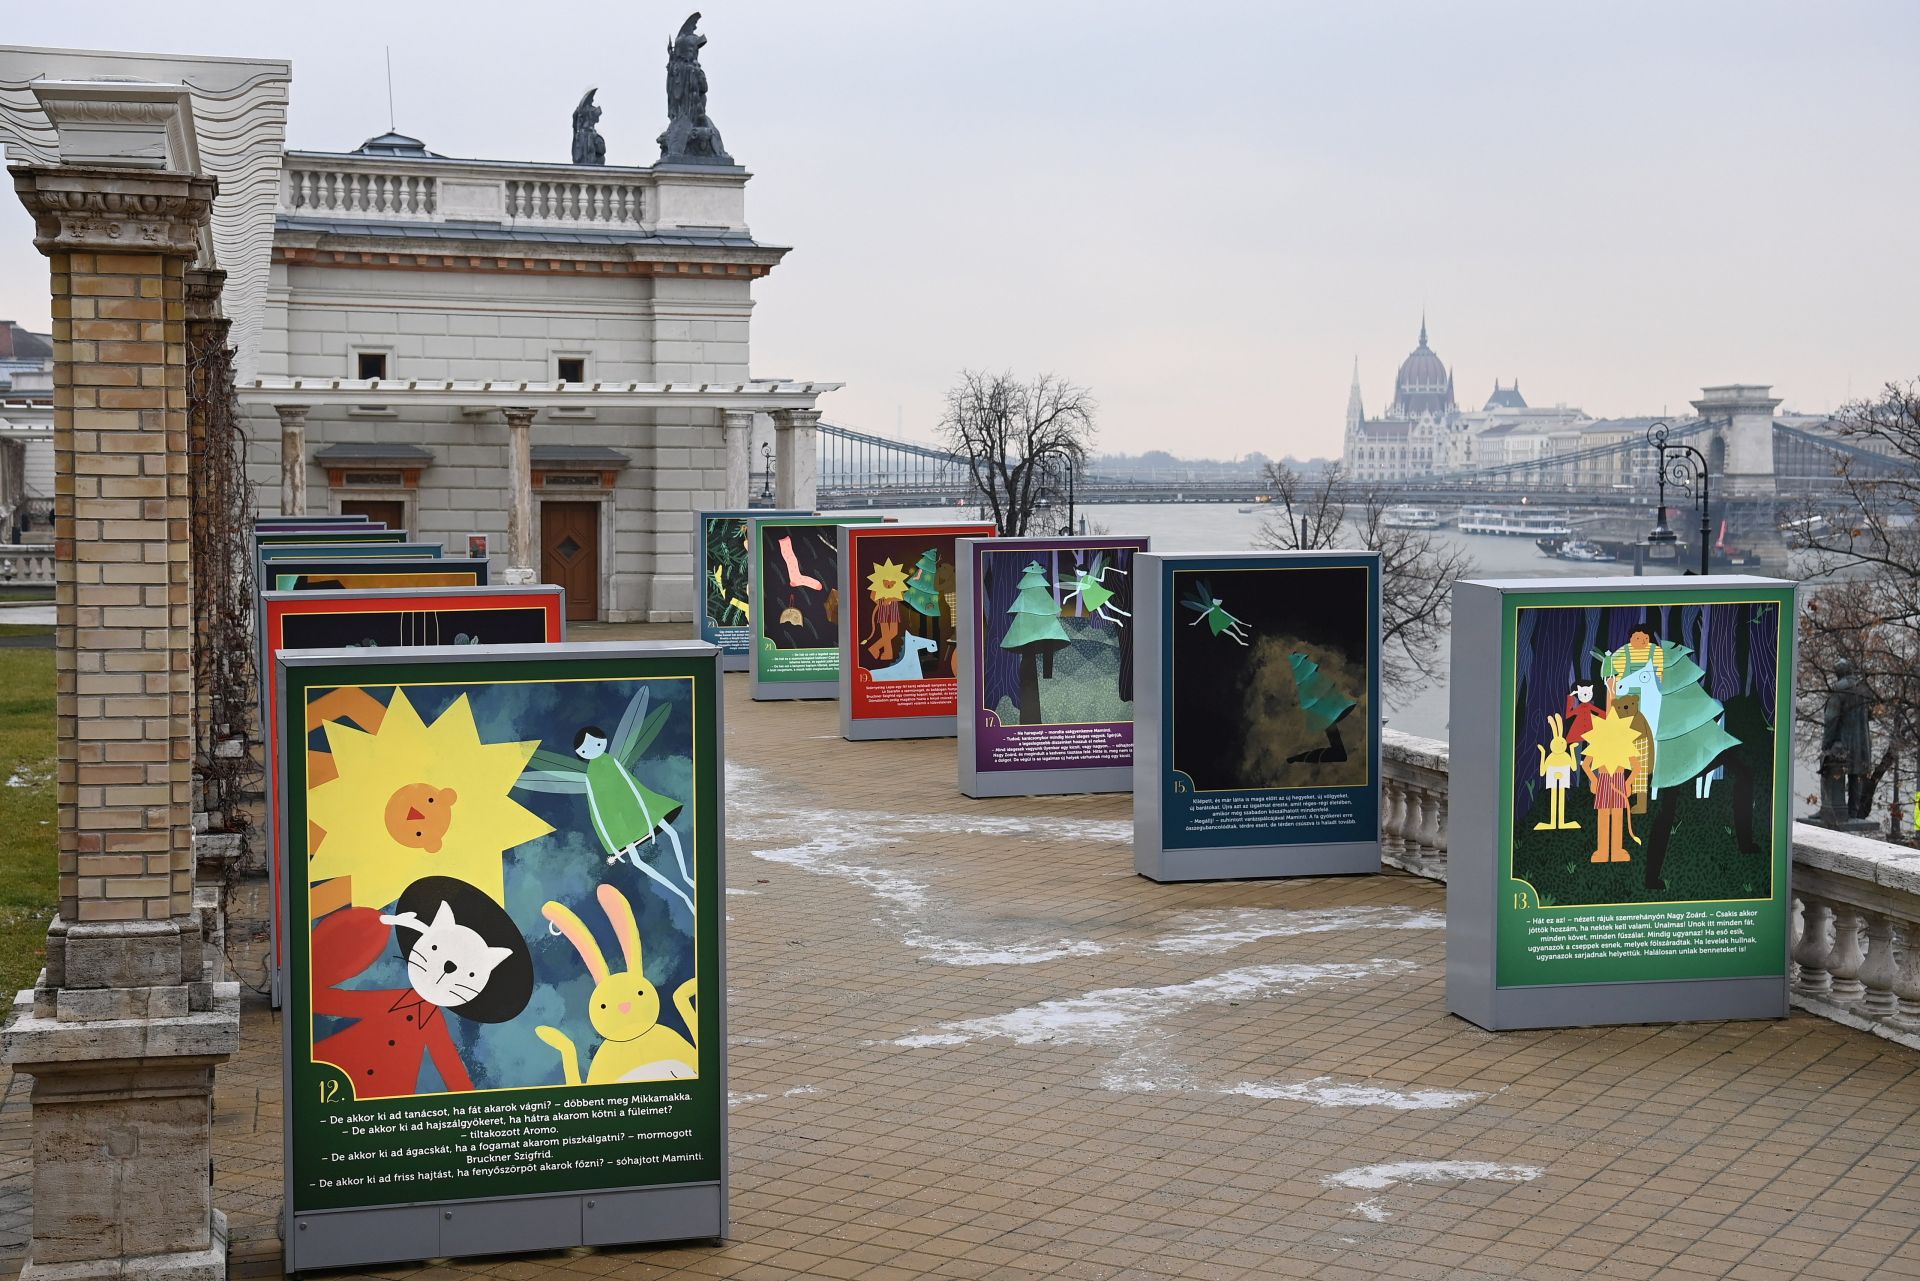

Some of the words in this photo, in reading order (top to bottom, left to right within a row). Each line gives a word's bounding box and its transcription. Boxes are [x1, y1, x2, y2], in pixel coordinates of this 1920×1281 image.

[985, 717, 996, 728] 17.
[1174, 780, 1187, 793] 15.
[1514, 892, 1530, 910] 13.
[1572, 942, 1600, 951] cseppek
[319, 1080, 345, 1103] 12.
[330, 1115, 343, 1124] De
[347, 1113, 375, 1122] akkor
[377, 1111, 386, 1120] ki
[389, 1110, 401, 1120] ad
[405, 1108, 450, 1119] tanácsot,
[453, 1106, 465, 1115] ha
[468, 1105, 481, 1114] fát
[484, 1102, 517, 1113] akarok
[520, 1100, 551, 1112] vágni?
[564, 1097, 604, 1108] döbbent
[607, 1097, 628, 1106] meg
[631, 1091, 692, 1103] Mikkamakka.
[352, 1126, 366, 1135] De
[369, 1124, 396, 1133] akkor
[399, 1122, 408, 1131] ki
[411, 1121, 423, 1130] ad
[509, 1115, 521, 1124] ha
[524, 1113, 550, 1123] hátra
[552, 1111, 589, 1121] akarom
[592, 1108, 617, 1118] kötni
[628, 1104, 672, 1116] füleimet?
[470, 1127, 520, 1139] tiltakozott
[523, 1127, 559, 1135] Aromo.
[331, 1153, 345, 1161] De
[348, 1150, 376, 1160] akkor
[379, 1148, 388, 1158] ki
[391, 1148, 403, 1157] ad
[406, 1144, 452, 1158] ágacskát,
[455, 1143, 468, 1152] ha
[479, 1140, 520, 1152] fogamat
[523, 1138, 560, 1147] akarom
[562, 1132, 625, 1147] piszkálgatni?
[637, 1127, 692, 1139] mormogott
[466, 1153, 512, 1163] Bruckner
[514, 1149, 554, 1162] Szigfrid.
[320, 1179, 333, 1187] De
[336, 1176, 364, 1186] akkor
[367, 1174, 376, 1184] ki
[379, 1173, 391, 1183] ad
[394, 1172, 415, 1182] friss
[418, 1170, 454, 1182] hajtást,
[457, 1168, 469, 1177] ha
[540, 1160, 572, 1171] akarok
[575, 1158, 604, 1168] főzni?
[616, 1154, 659, 1166] sóhajtott
[662, 1151, 704, 1162] Maminti.
